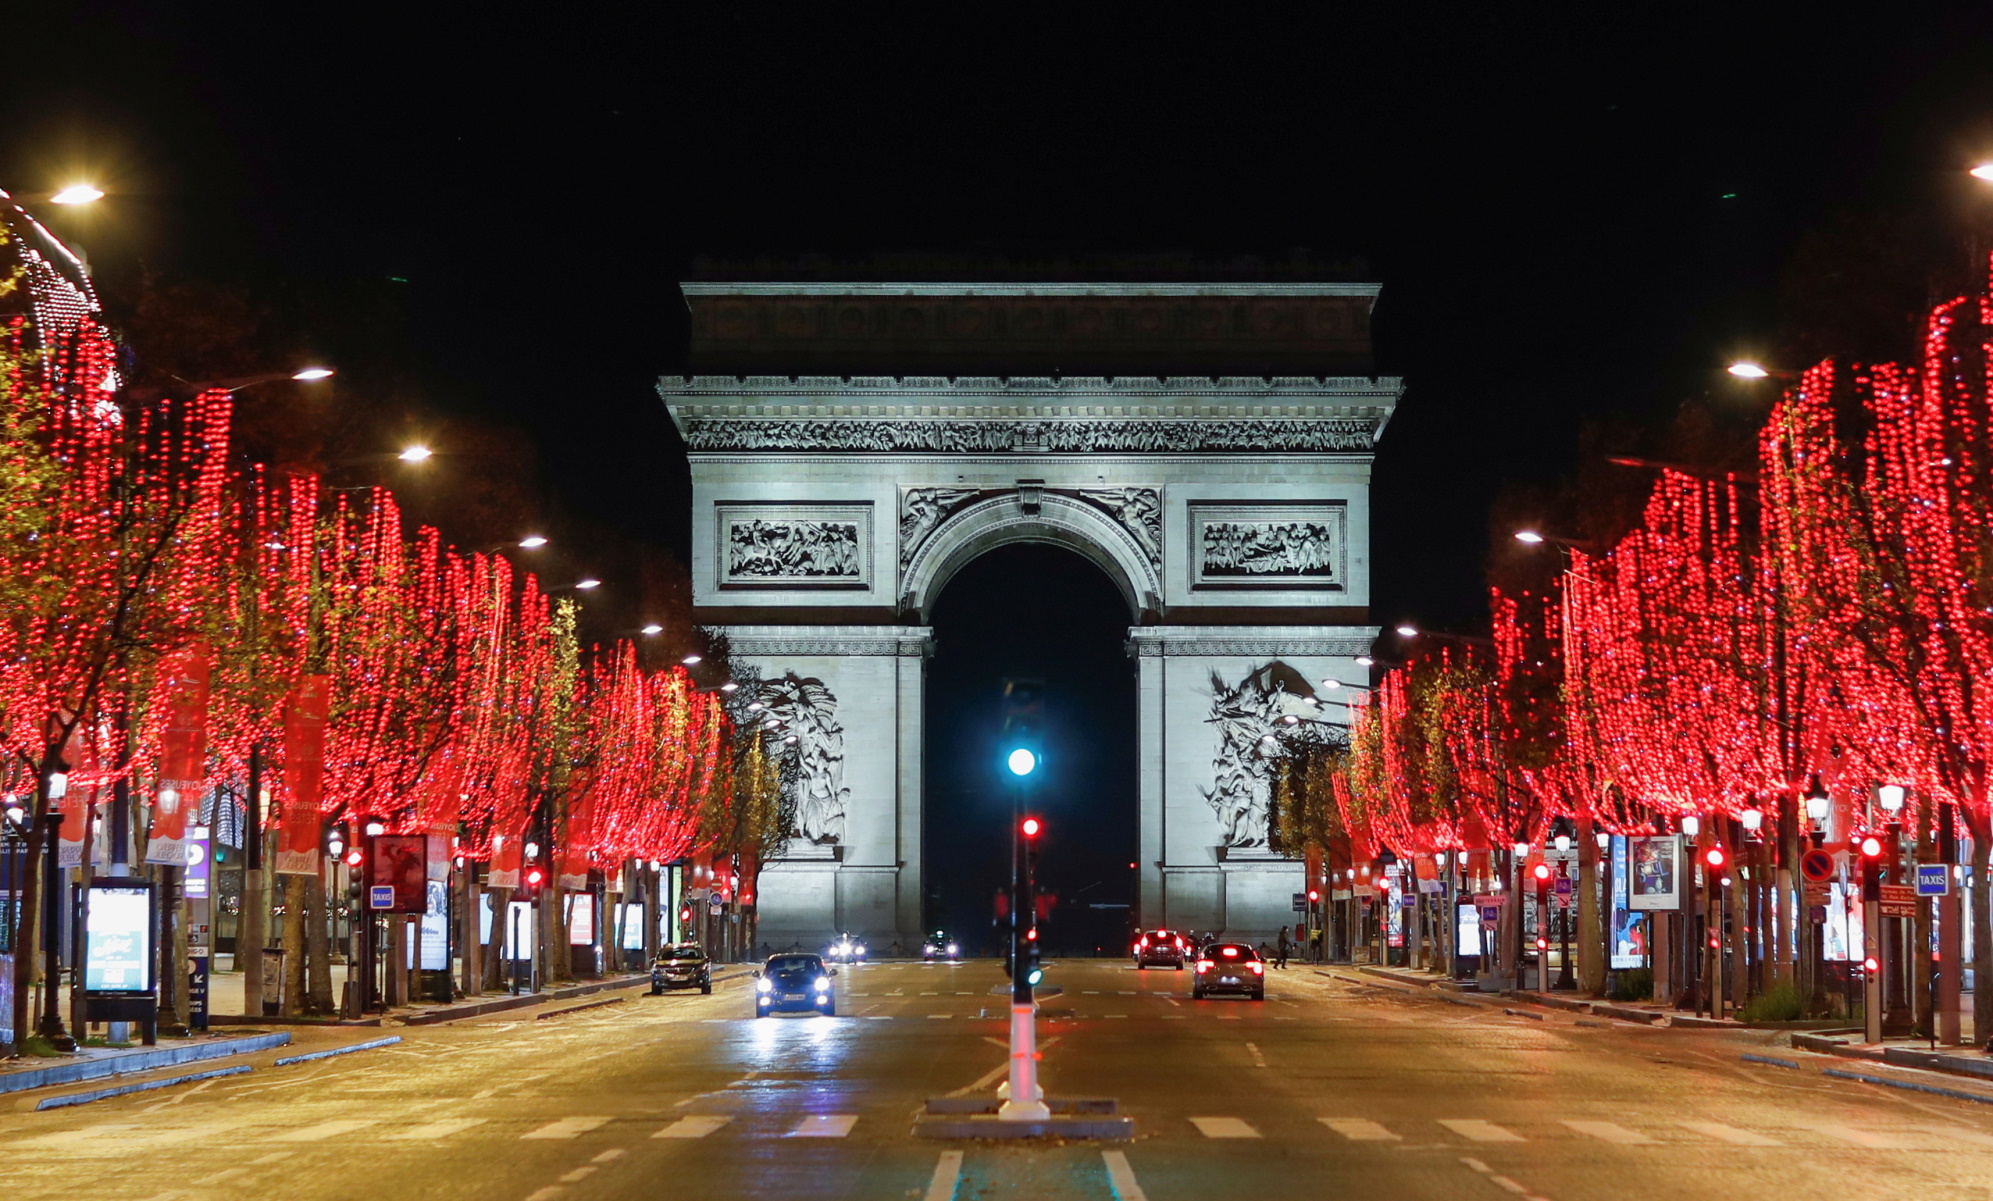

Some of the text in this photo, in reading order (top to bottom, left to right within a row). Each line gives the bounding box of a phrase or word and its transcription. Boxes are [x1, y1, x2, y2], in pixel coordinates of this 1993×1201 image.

[1636, 861, 1669, 883] SOUL
[1920, 875, 1945, 885] TAXIS
[373, 893, 392, 901] TAXIS
